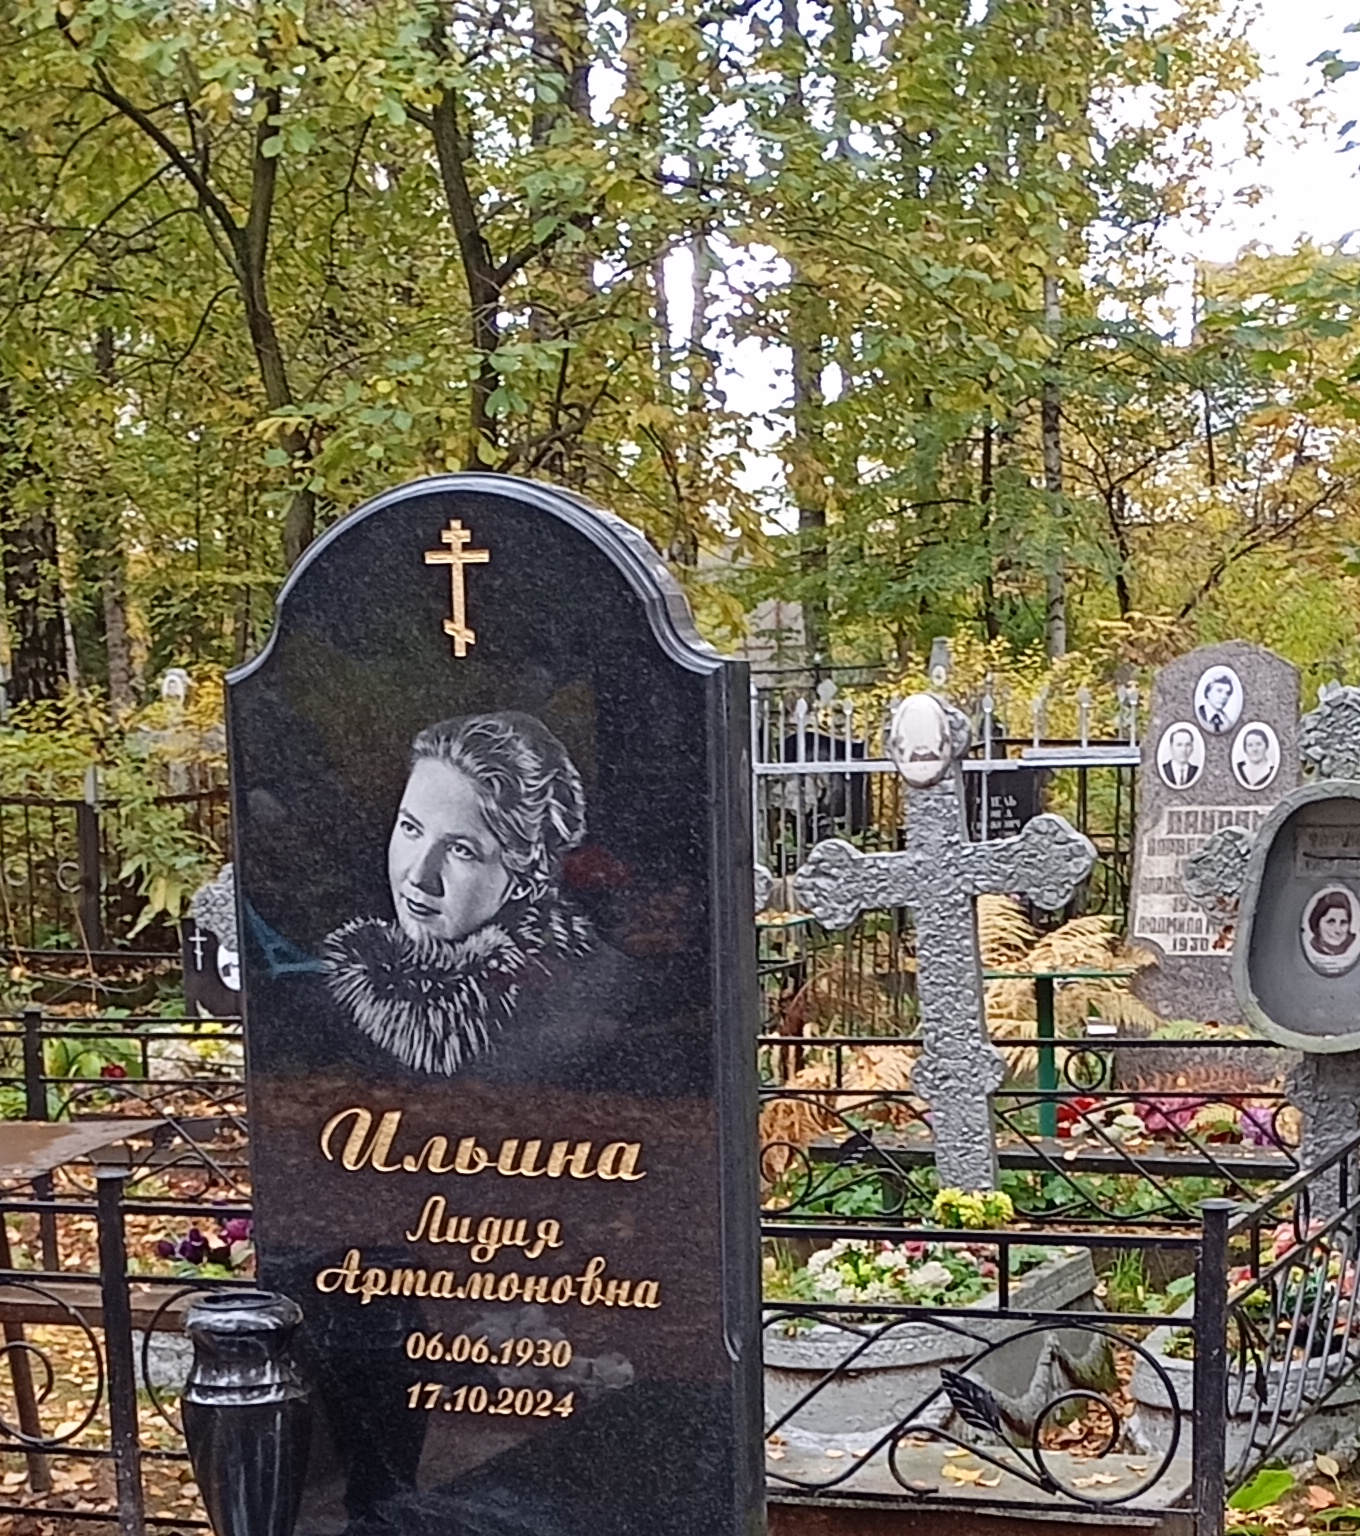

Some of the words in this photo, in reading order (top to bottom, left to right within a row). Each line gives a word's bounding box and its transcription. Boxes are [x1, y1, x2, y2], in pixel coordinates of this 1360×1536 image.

[321, 1106, 647, 1181] Ильина
[406, 1195, 564, 1263] Лидия
[316, 1248, 663, 1309] Артамоновна
[406, 1332, 573, 1368] 06.06.1930
[406, 1381, 575, 1418] 17.10.2024
